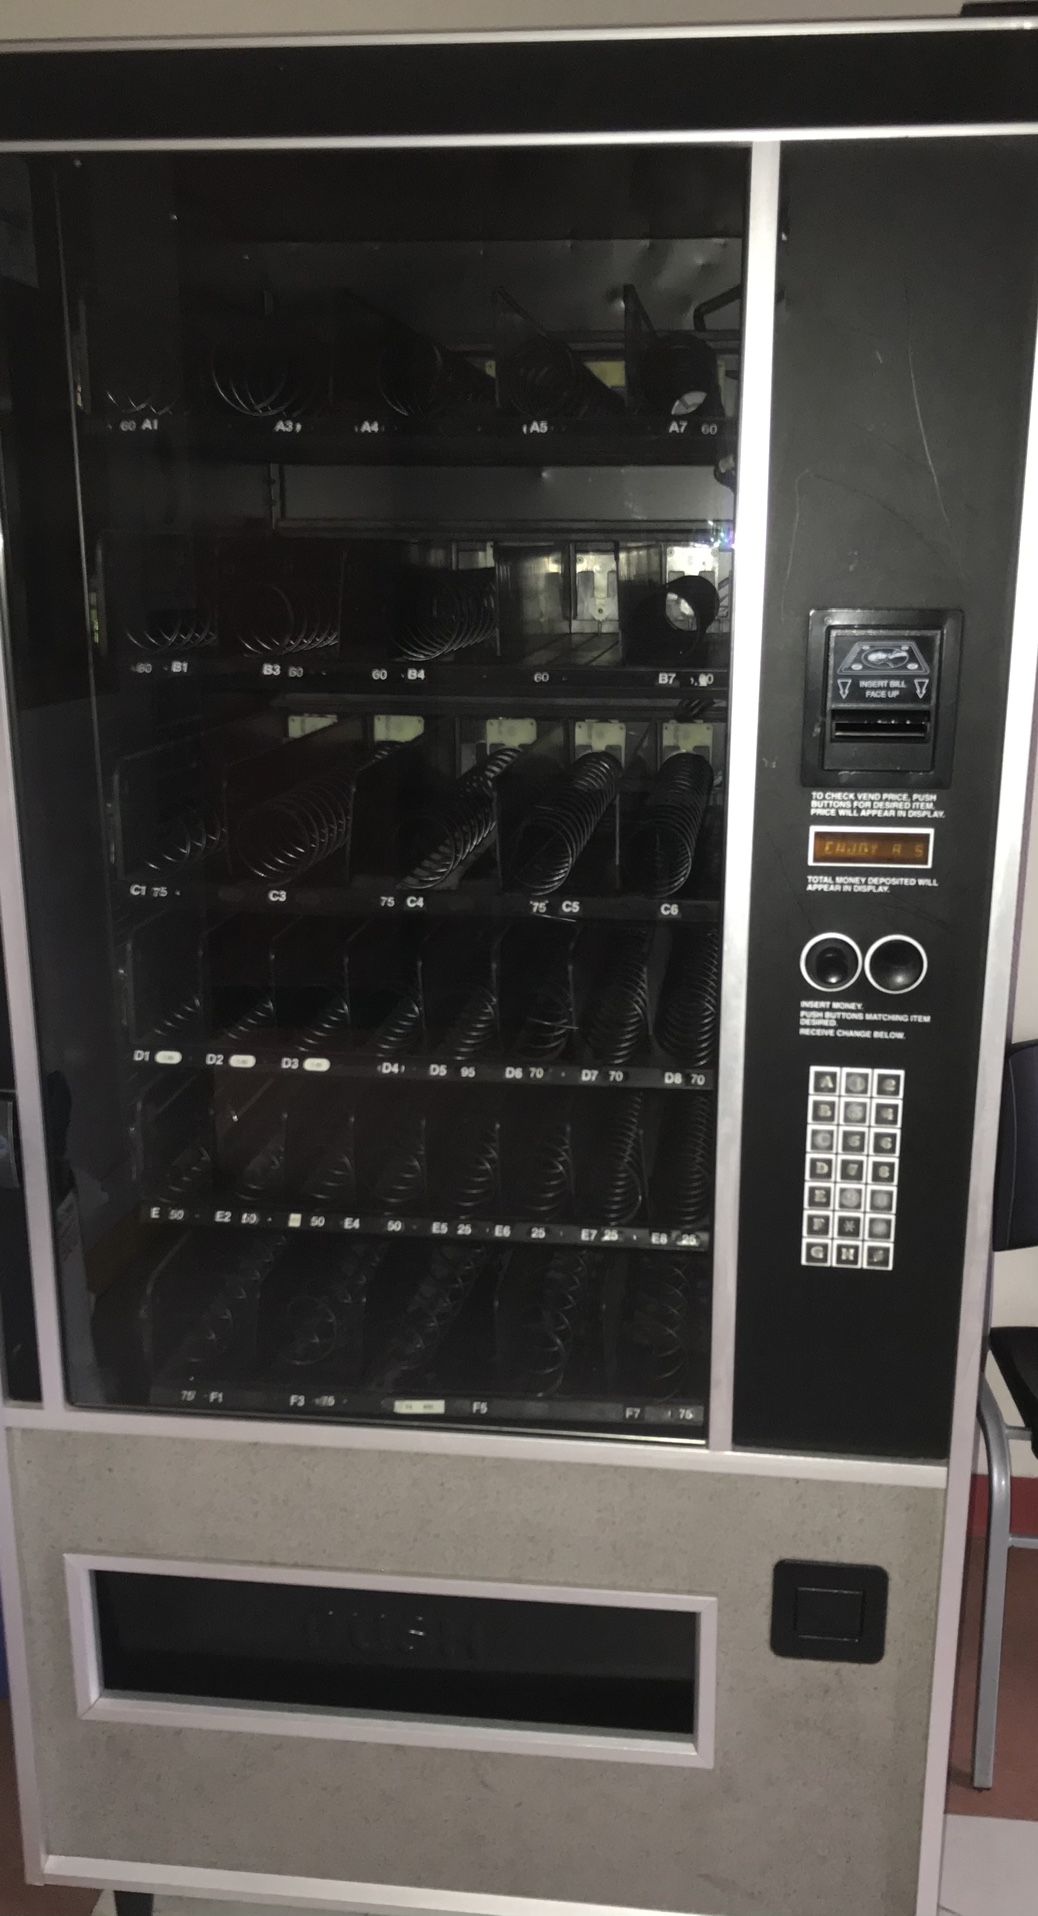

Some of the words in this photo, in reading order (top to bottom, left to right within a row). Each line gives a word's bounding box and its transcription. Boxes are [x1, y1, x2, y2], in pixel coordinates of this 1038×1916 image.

[141, 419, 158, 430] A1
[274, 420, 293, 432] A3
[360, 421, 379, 433] A4
[530, 421, 548, 433] A5
[669, 421, 688, 433] A7
[701, 424, 718, 434] 60
[171, 661, 188, 672] B1
[263, 664, 281, 676] B3
[407, 669, 425, 680] B4
[534, 673, 549, 682] 60
[658, 673, 676, 684] B7
[860, 680, 887, 688] INSERT
[825, 792, 855, 800] CHECK
[860, 809, 895, 817] APPEAR
[807, 876, 834, 884] TOTAL
[868, 877, 916, 885] DEPOSITED
[130, 885, 146, 896] C1
[152, 887, 167, 897] 75
[268, 890, 286, 901] C3
[380, 897, 395, 907] 75
[406, 896, 424, 908] C4
[562, 901, 579, 912] C5
[661, 904, 679, 916] C6
[800, 1010, 823, 1019] PUSH
[824, 1012, 864, 1020] BUTTONS
[865, 1013, 908, 1021] MATCHING
[800, 1028, 835, 1036] RECEIVE
[836, 1029, 872, 1038] CHANGE
[133, 1051, 150, 1061] D1
[206, 1054, 224, 1065] D2
[281, 1058, 299, 1069] D3
[382, 1063, 399, 1074] D4
[429, 1064, 447, 1076] D5
[460, 1067, 476, 1077] 95
[505, 1067, 523, 1079] D6
[529, 1067, 544, 1078] 70
[581, 1069, 598, 1081] D7
[609, 1071, 624, 1082] 70
[664, 1072, 682, 1084] D8
[690, 1074, 705, 1085] 70
[821, 1075, 833, 1088] A
[816, 1162, 828, 1174] D
[168, 1210, 184, 1220] 50
[214, 1211, 232, 1222] E2
[310, 1216, 325, 1227] 50
[344, 1217, 360, 1229] E4
[432, 1222, 448, 1234] E5
[457, 1224, 472, 1235] 25
[495, 1225, 511, 1237] E6
[531, 1227, 545, 1238] 25
[581, 1229, 598, 1241] E7
[209, 1392, 223, 1402] F1
[290, 1395, 305, 1406] F3
[626, 1408, 640, 1419] F7
[679, 1408, 693, 1420] 75
